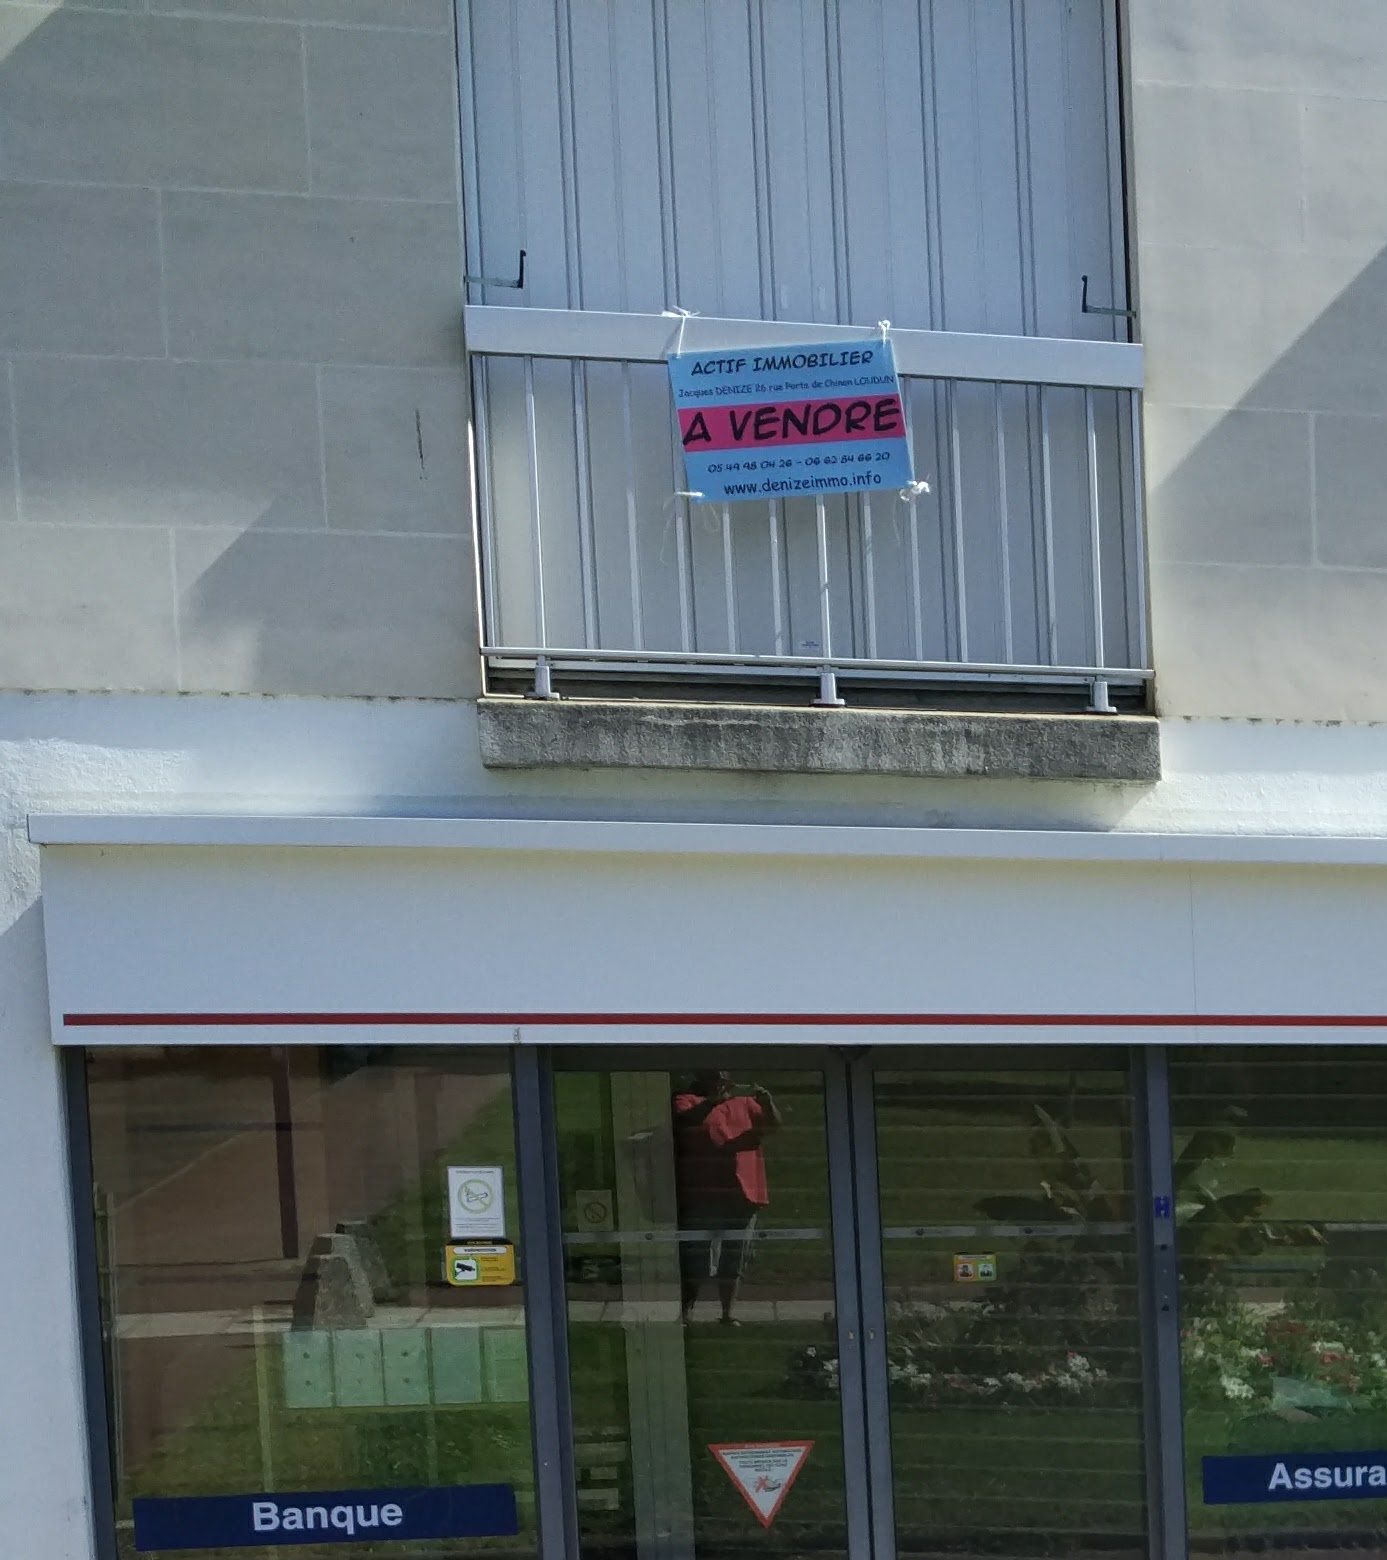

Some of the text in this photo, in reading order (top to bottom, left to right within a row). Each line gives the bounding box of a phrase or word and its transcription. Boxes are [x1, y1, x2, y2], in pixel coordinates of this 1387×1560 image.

[691, 350, 874, 376] ACTIF IMMOBILIER
[679, 388, 714, 399] Jacques
[716, 385, 752, 396] DENIZE
[768, 383, 784, 392] rue
[812, 380, 823, 389] de
[854, 375, 894, 386] LOUDUN
[682, 398, 901, 446] A VENDRE
[707, 464, 723, 474] 05
[725, 462, 740, 472] 49
[760, 460, 776, 470] 04
[778, 458, 792, 468] 26
[805, 457, 821, 466] 06
[824, 455, 838, 465] 62
[875, 451, 890, 461] 20
[724, 470, 882, 495] www.denizeimmo.info
[252, 1501, 403, 1535] Banque
